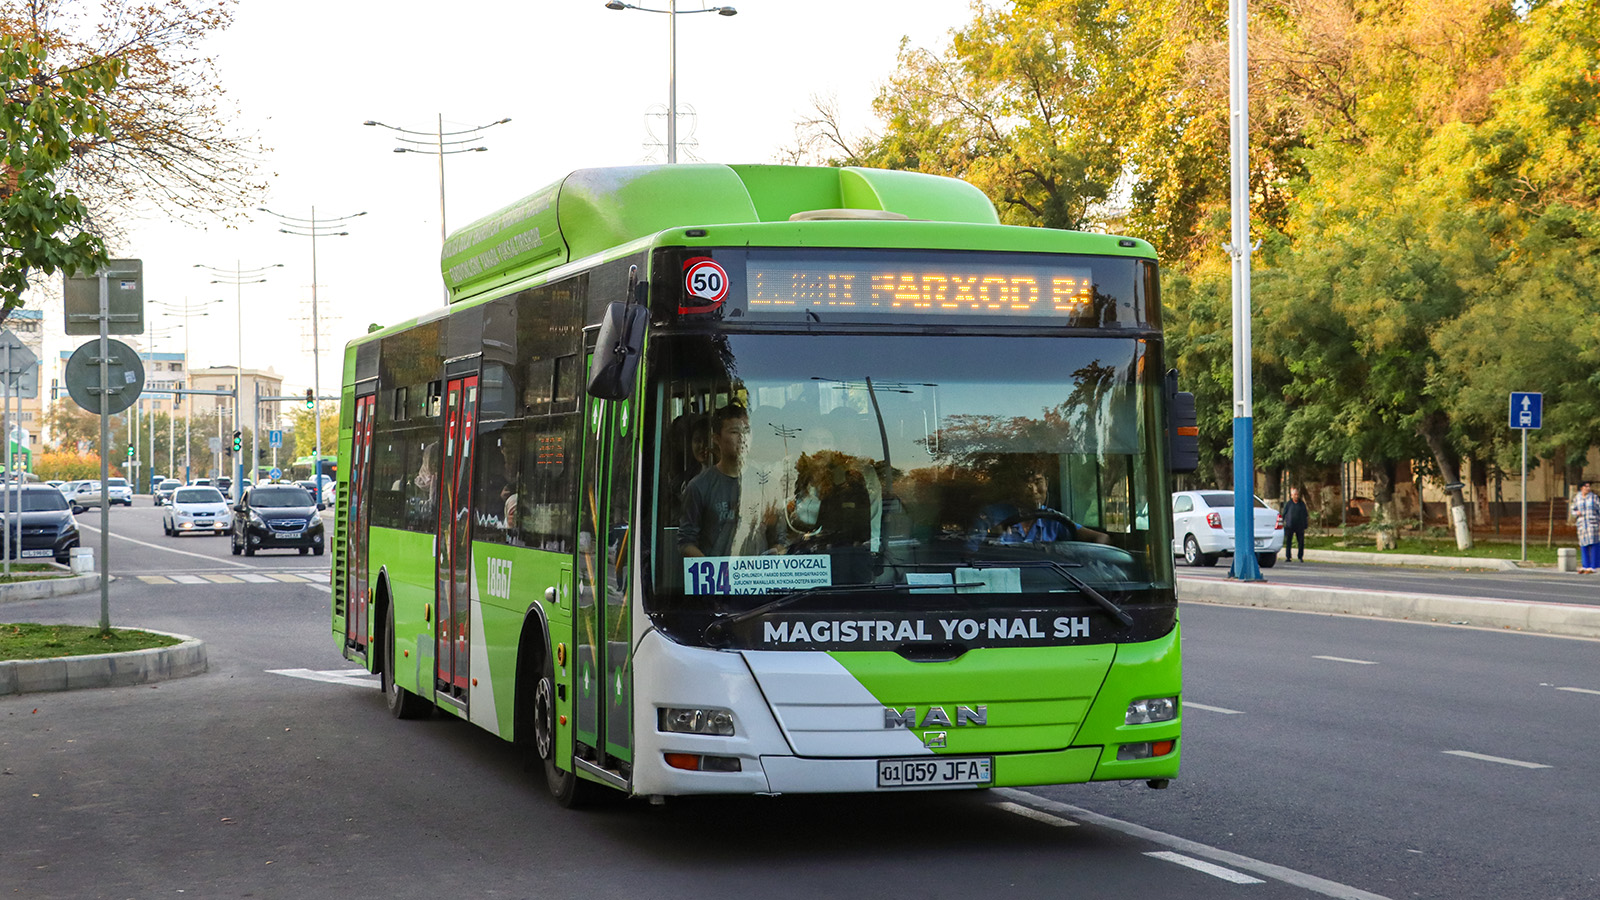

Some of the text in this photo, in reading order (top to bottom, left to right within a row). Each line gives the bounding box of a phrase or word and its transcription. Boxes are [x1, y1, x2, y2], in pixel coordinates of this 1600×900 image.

[694, 273, 721, 291] 50
[872, 275, 1038, 308] FARXOD
[733, 559, 827, 570] JANUBIY VOKZAL
[487, 556, 513, 600] 18667
[688, 561, 731, 595] 134
[763, 620, 932, 643] MAGISTRAL
[1053, 616, 1090, 638] SH
[884, 705, 988, 728] MAN
[884, 761, 979, 782] 01 059 JFA
